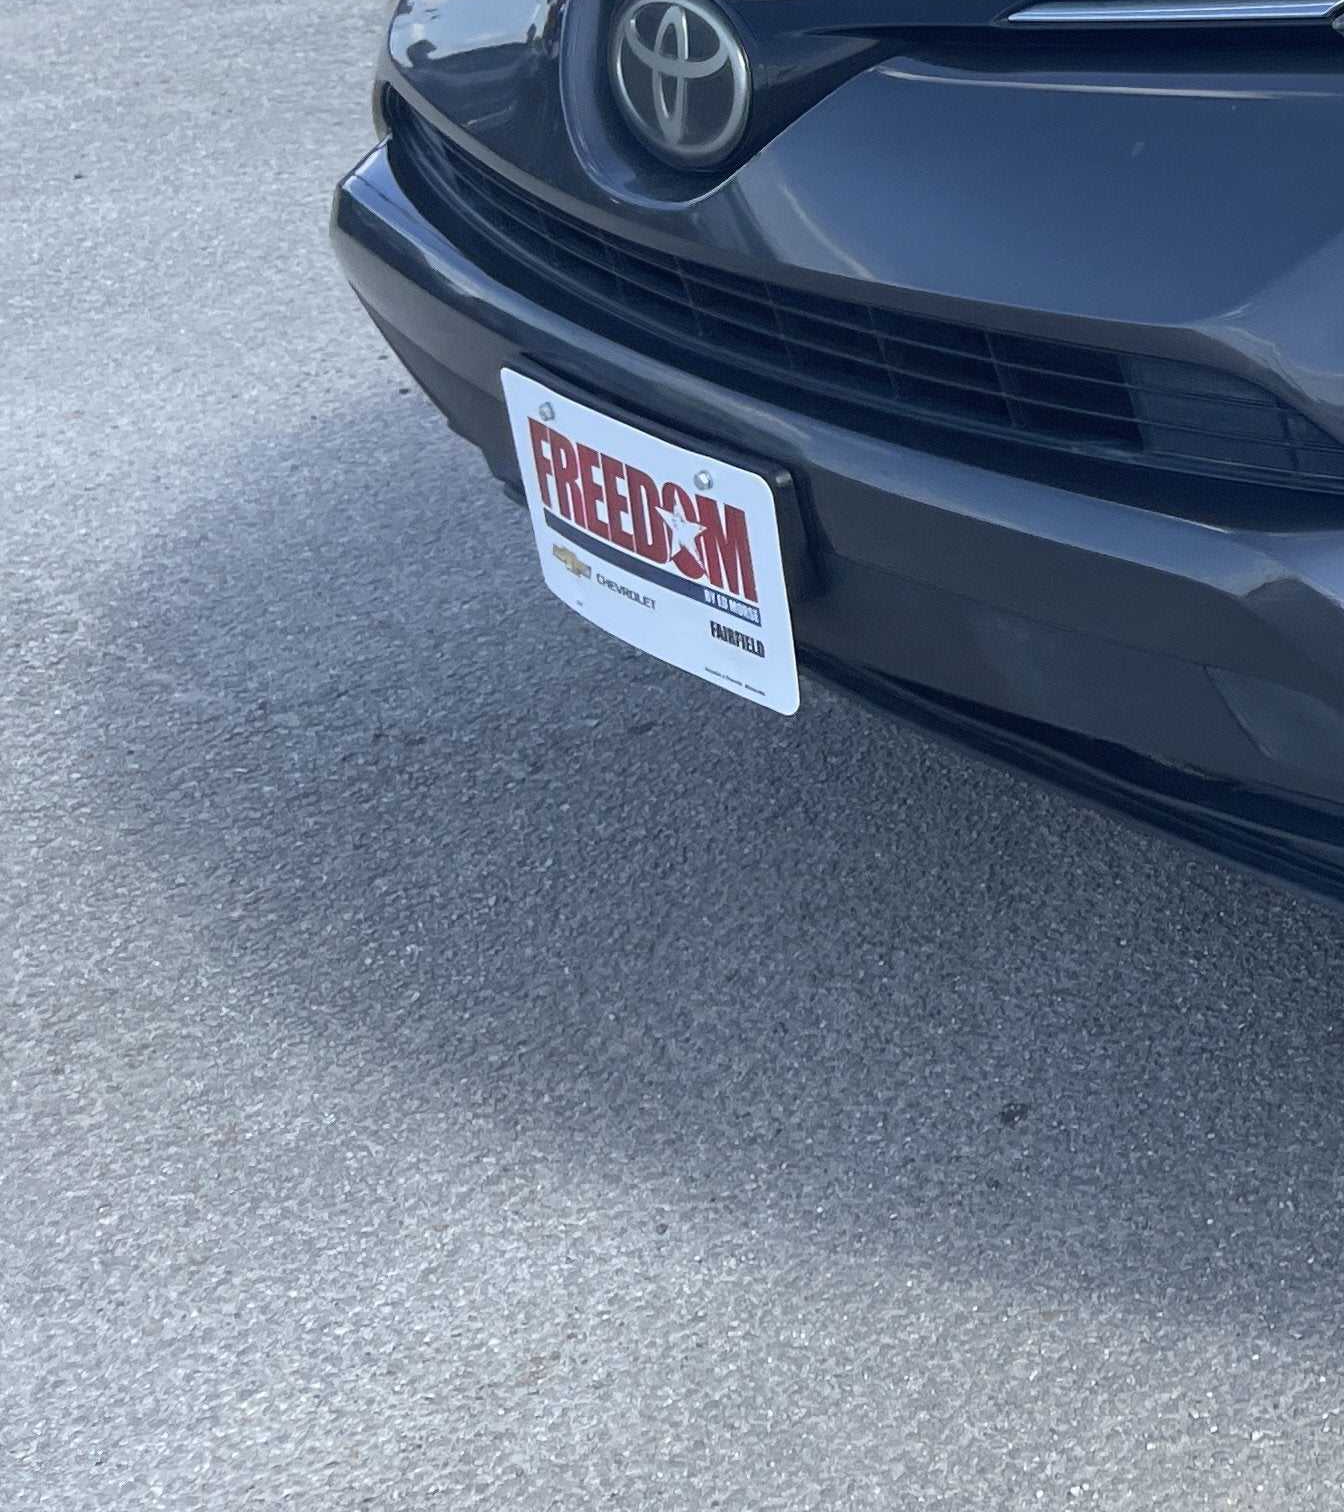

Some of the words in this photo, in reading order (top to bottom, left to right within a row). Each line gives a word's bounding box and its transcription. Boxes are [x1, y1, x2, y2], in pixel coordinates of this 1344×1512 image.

[527, 416, 759, 603] FREEDOM
[596, 573, 656, 610] CHEVROLET
[710, 620, 766, 658] FAIRFIELD
